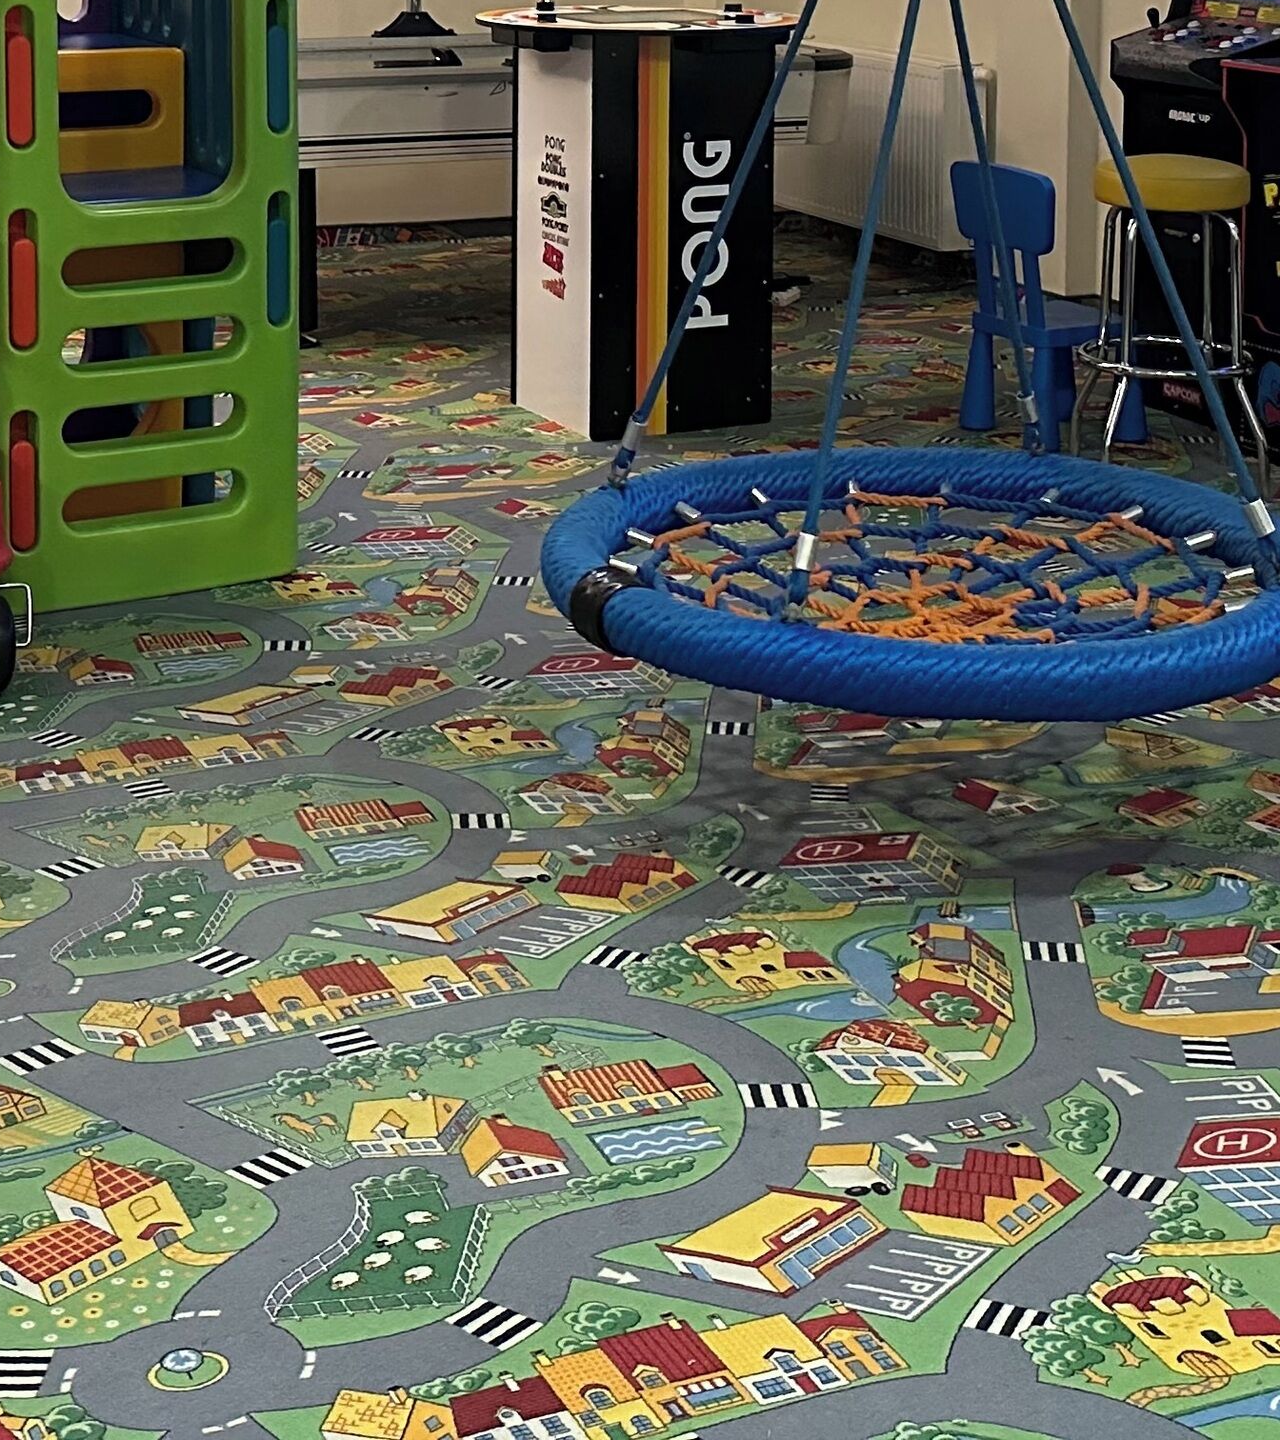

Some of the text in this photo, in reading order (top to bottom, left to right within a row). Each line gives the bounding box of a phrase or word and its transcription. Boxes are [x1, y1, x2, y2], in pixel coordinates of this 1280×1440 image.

[545, 134, 566, 153] PONG
[681, 138, 731, 330] PONG
[813, 844, 842, 857] H
[1221, 1080, 1256, 1092] P
[1237, 1098, 1272, 1111] P
[1216, 1133, 1249, 1153] H
[944, 1246, 978, 1260] P
[924, 1261, 959, 1276] P
[900, 1279, 934, 1293] P
[879, 1295, 914, 1311] P
